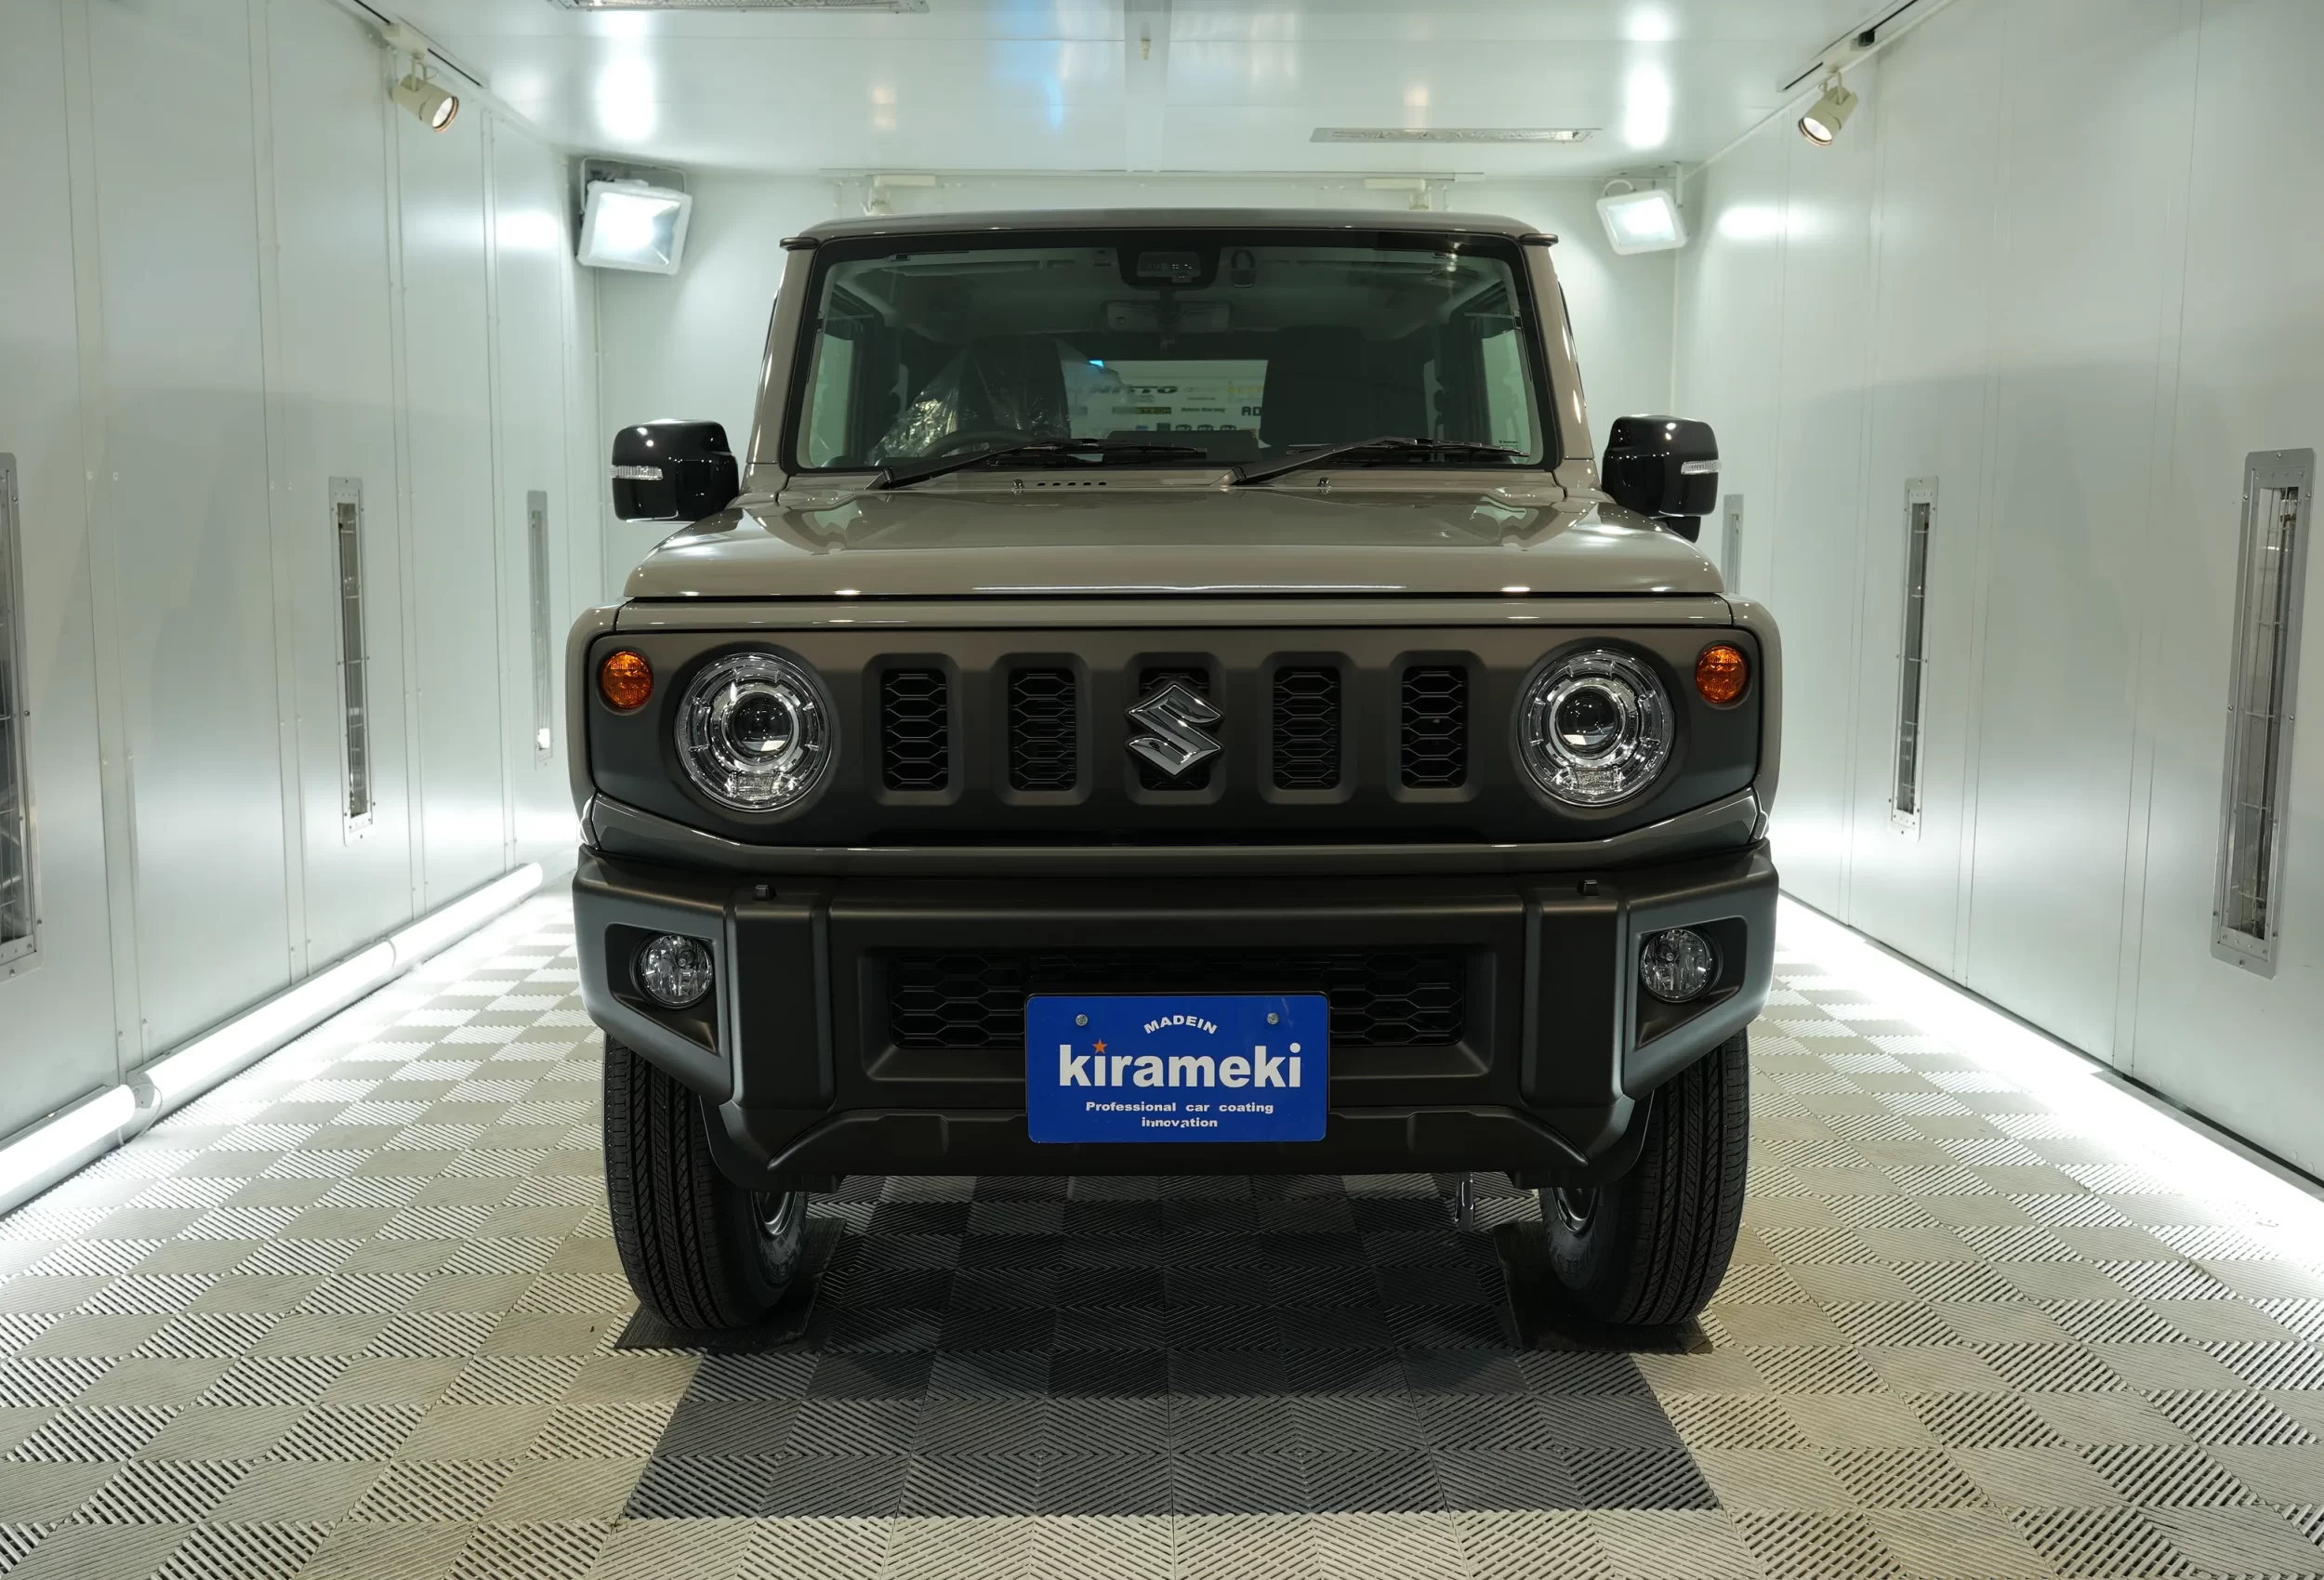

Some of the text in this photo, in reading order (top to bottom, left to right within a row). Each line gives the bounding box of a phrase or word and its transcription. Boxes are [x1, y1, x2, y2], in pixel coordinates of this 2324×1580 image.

[1059, 1039, 1301, 1088] kirameki
[1086, 1101, 1274, 1114] Professional car coating
[1142, 1117, 1218, 1128] innovation
